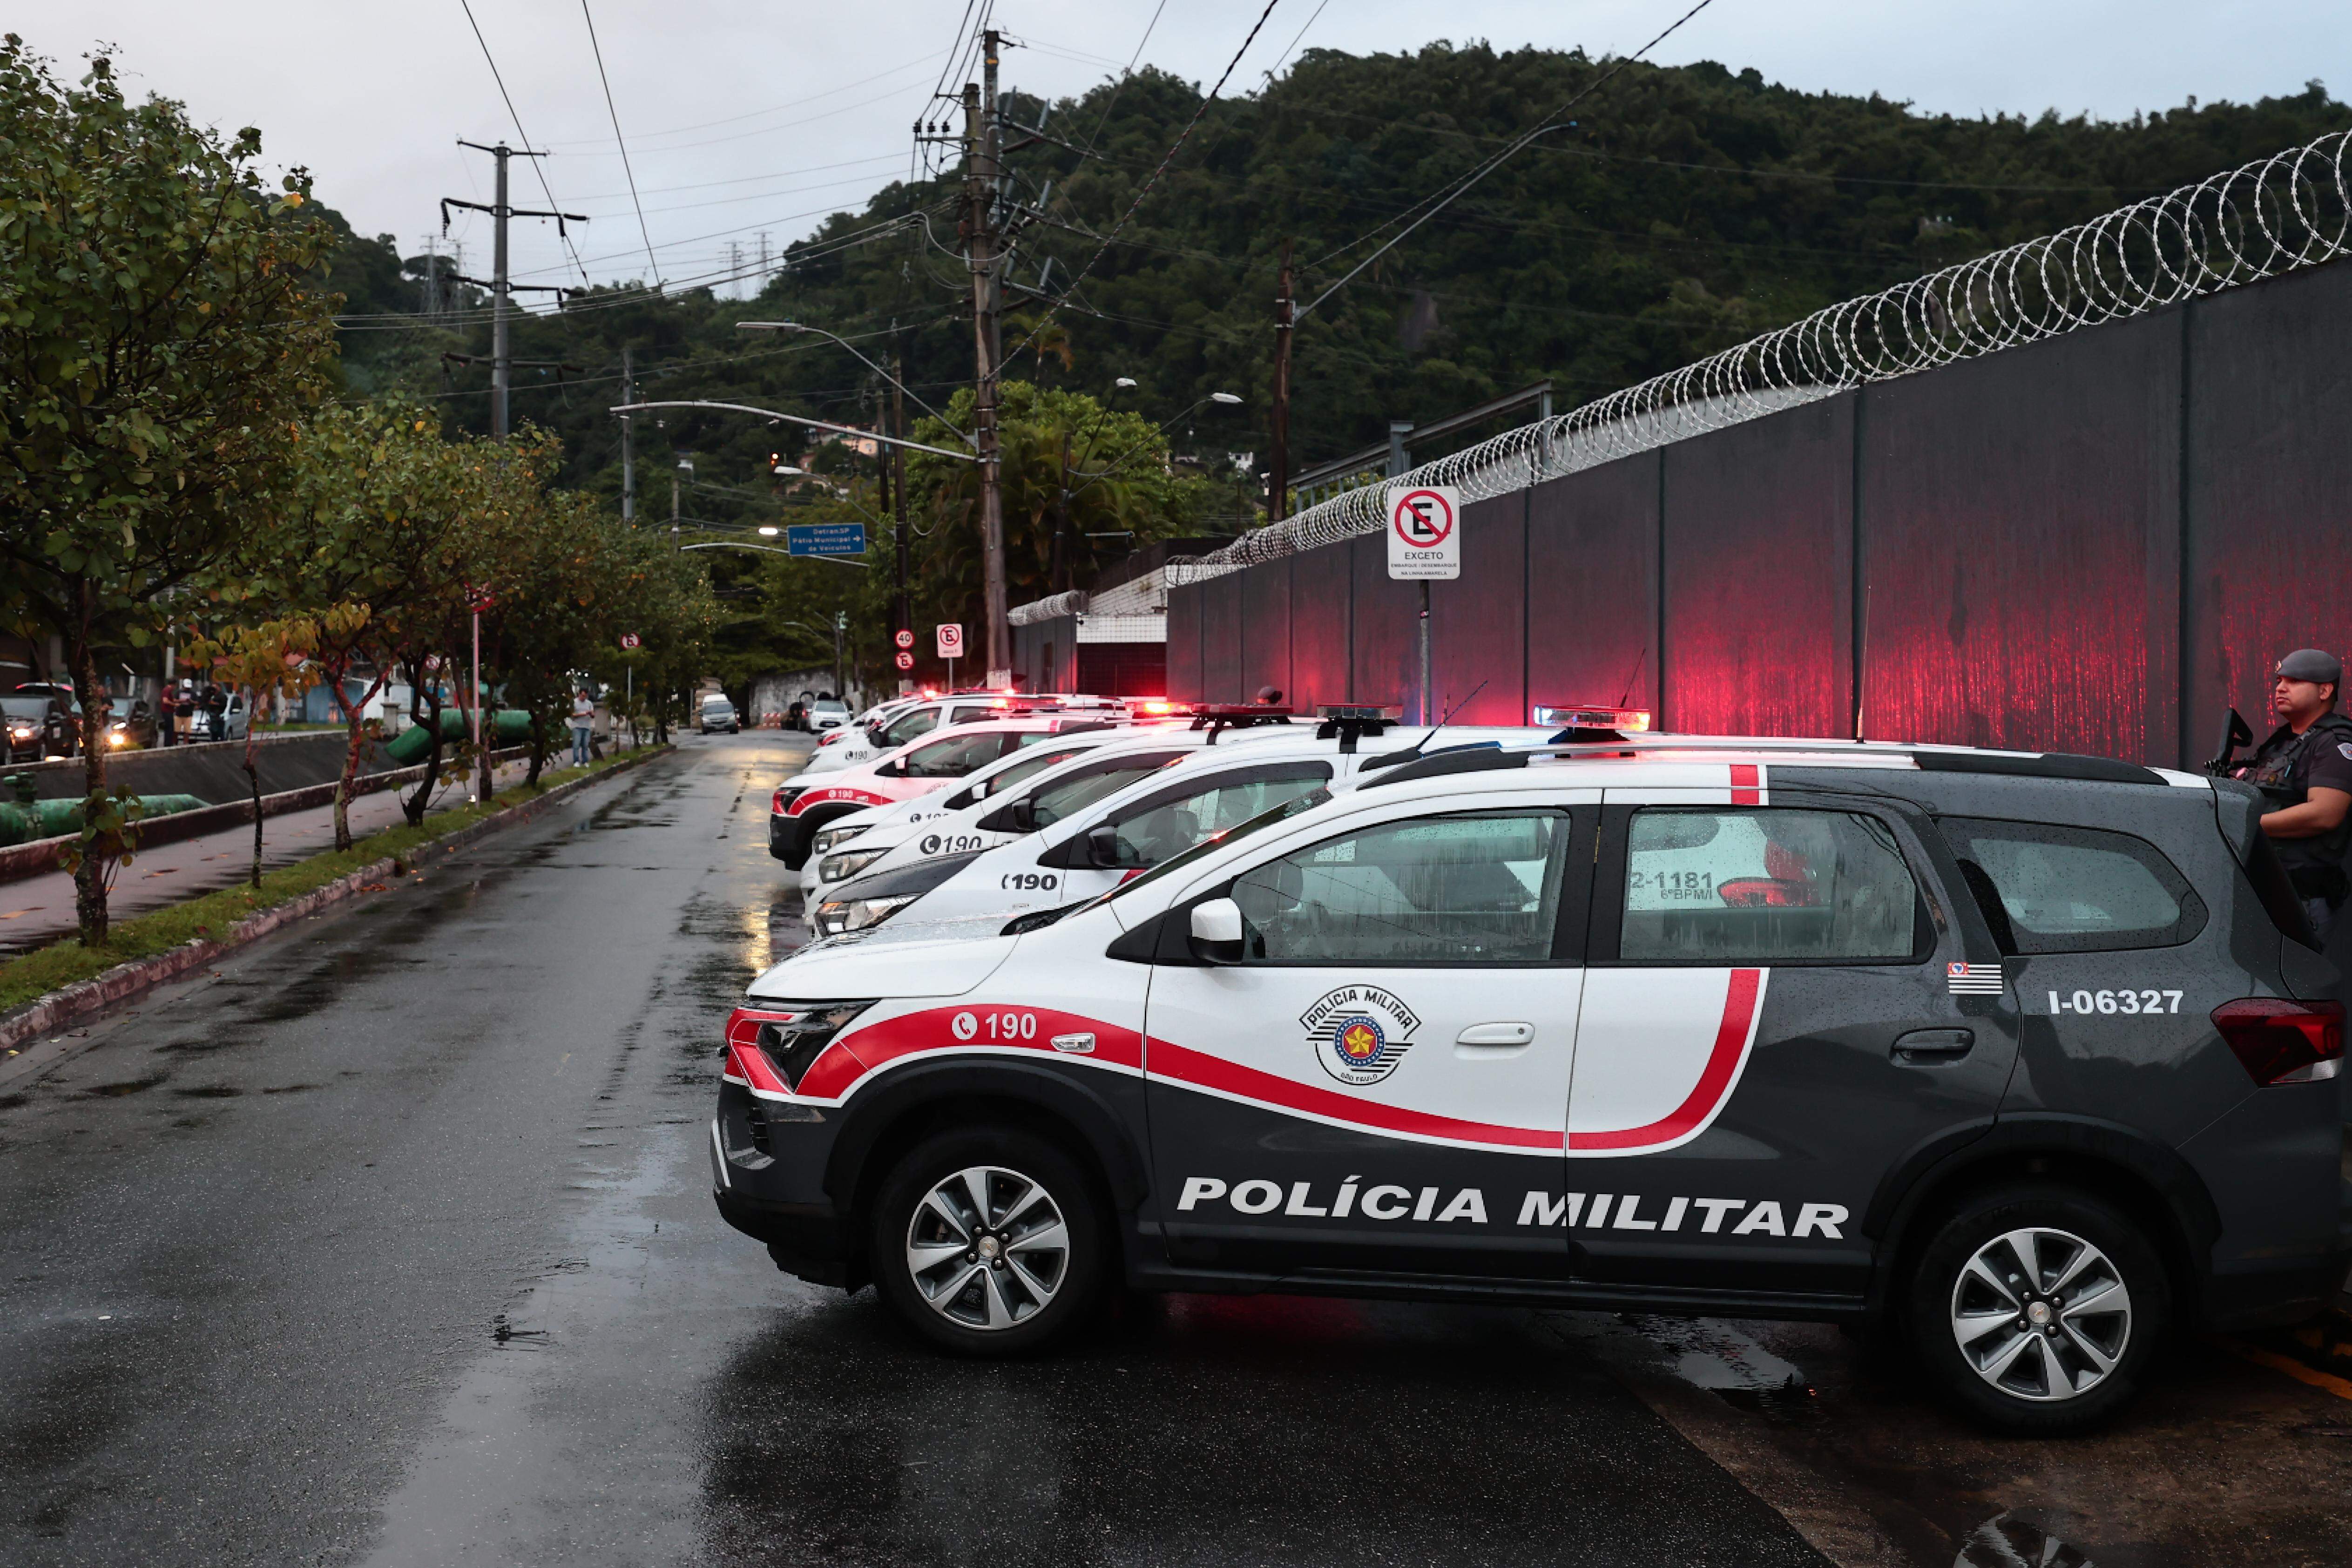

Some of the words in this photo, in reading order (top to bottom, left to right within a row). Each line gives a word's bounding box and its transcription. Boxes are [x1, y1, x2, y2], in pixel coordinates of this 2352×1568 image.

[1413, 503, 1433, 534] E
[899, 634, 911, 642] 40
[943, 836, 982, 853] 190
[1012, 873, 1057, 890] 190
[1307, 989, 1358, 1027] POLÍCIA
[1364, 989, 1413, 1029] MILITAR
[2048, 989, 2183, 1014] I-06327
[985, 1013, 1036, 1040] 190
[1176, 1175, 1488, 1223] POLÍCIA
[1516, 1191, 1849, 1239] MILITAR
